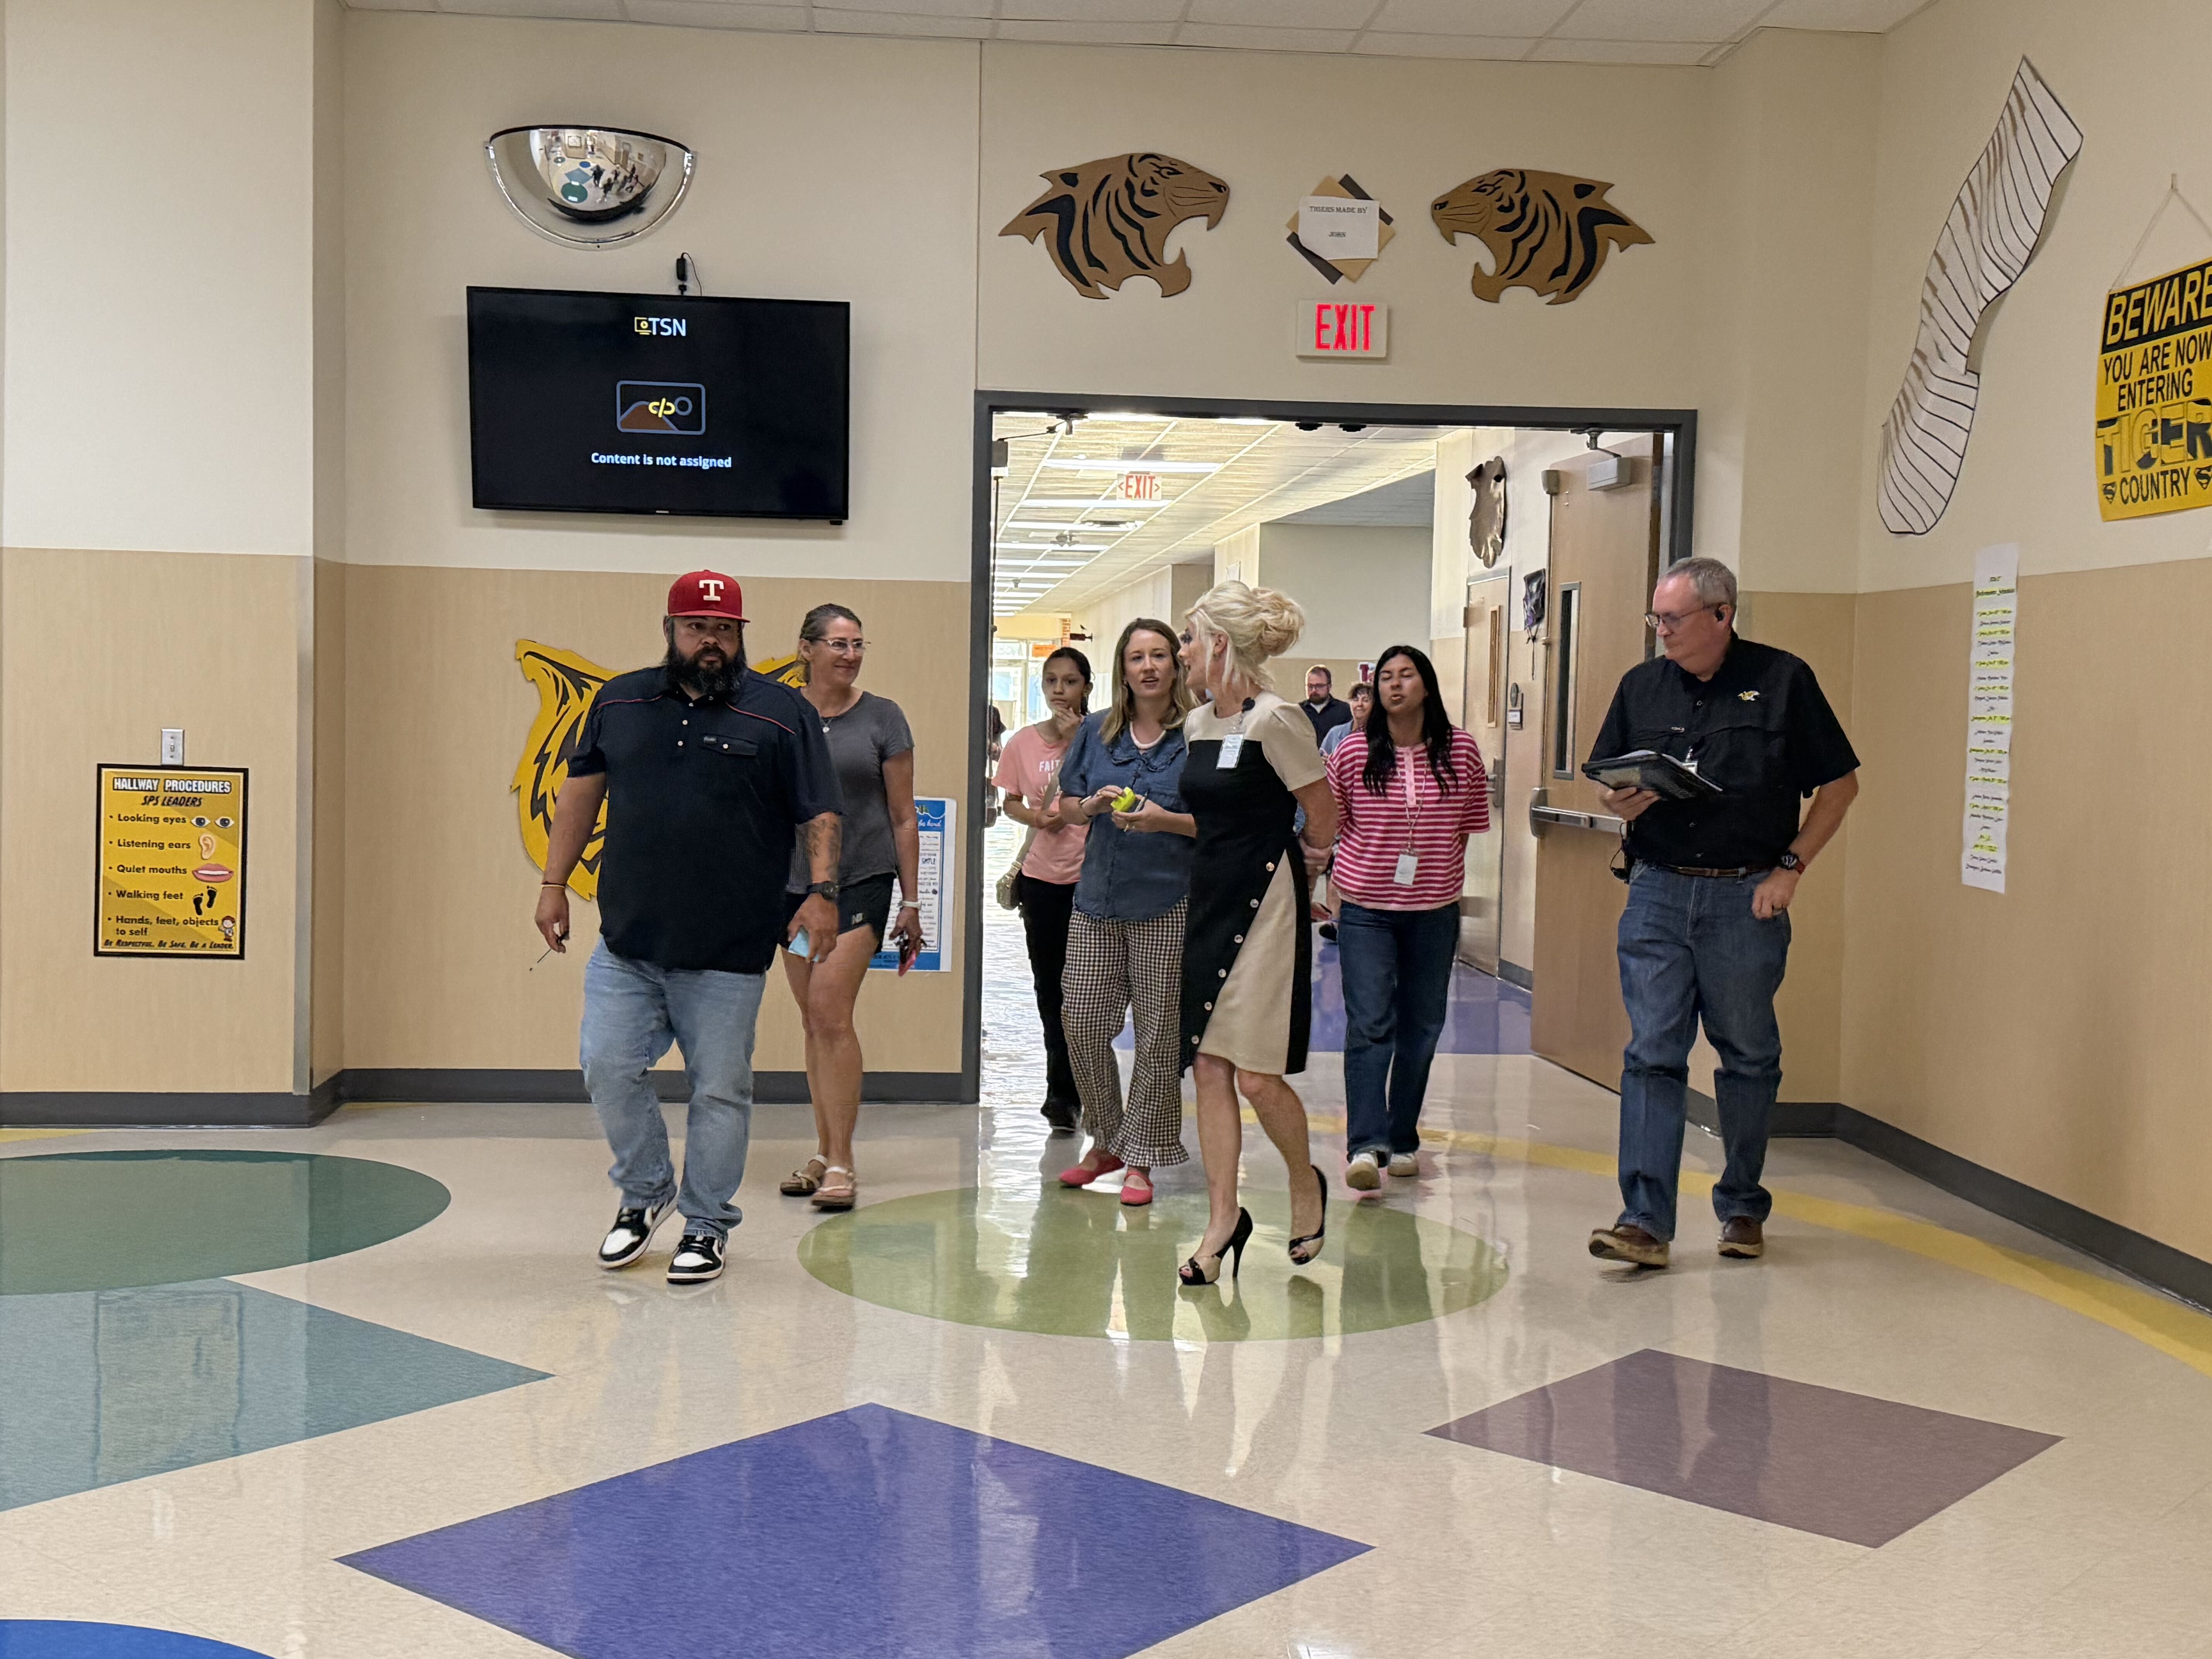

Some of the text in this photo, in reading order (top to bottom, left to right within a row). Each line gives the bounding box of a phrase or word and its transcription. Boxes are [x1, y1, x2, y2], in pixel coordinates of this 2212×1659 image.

[2107, 266, 2212, 345] BEWARE
[648, 317, 686, 336] TSN
[1315, 303, 1376, 351] EXIT
[2104, 330, 2212, 385] YOU ARE NOW
[2118, 368, 2193, 412] ENTERING
[2096, 397, 2212, 476] TIGER
[591, 452, 732, 469] Content is not assigned
[1125, 475, 1156, 499] EXIT
[2120, 465, 2190, 505] COUNTRY
[699, 579, 724, 601] T
[113, 778, 231, 794] HALLWAY PROCEDURES
[141, 795, 202, 807] SPS LEADERS
[118, 814, 186, 824] Looking eyes
[117, 839, 165, 850] Listening
[117, 864, 187, 875] Quiet mouths
[116, 890, 183, 901] Walking feet
[116, 916, 219, 927] Hands, feet, objects
[129, 927, 148, 936] self
